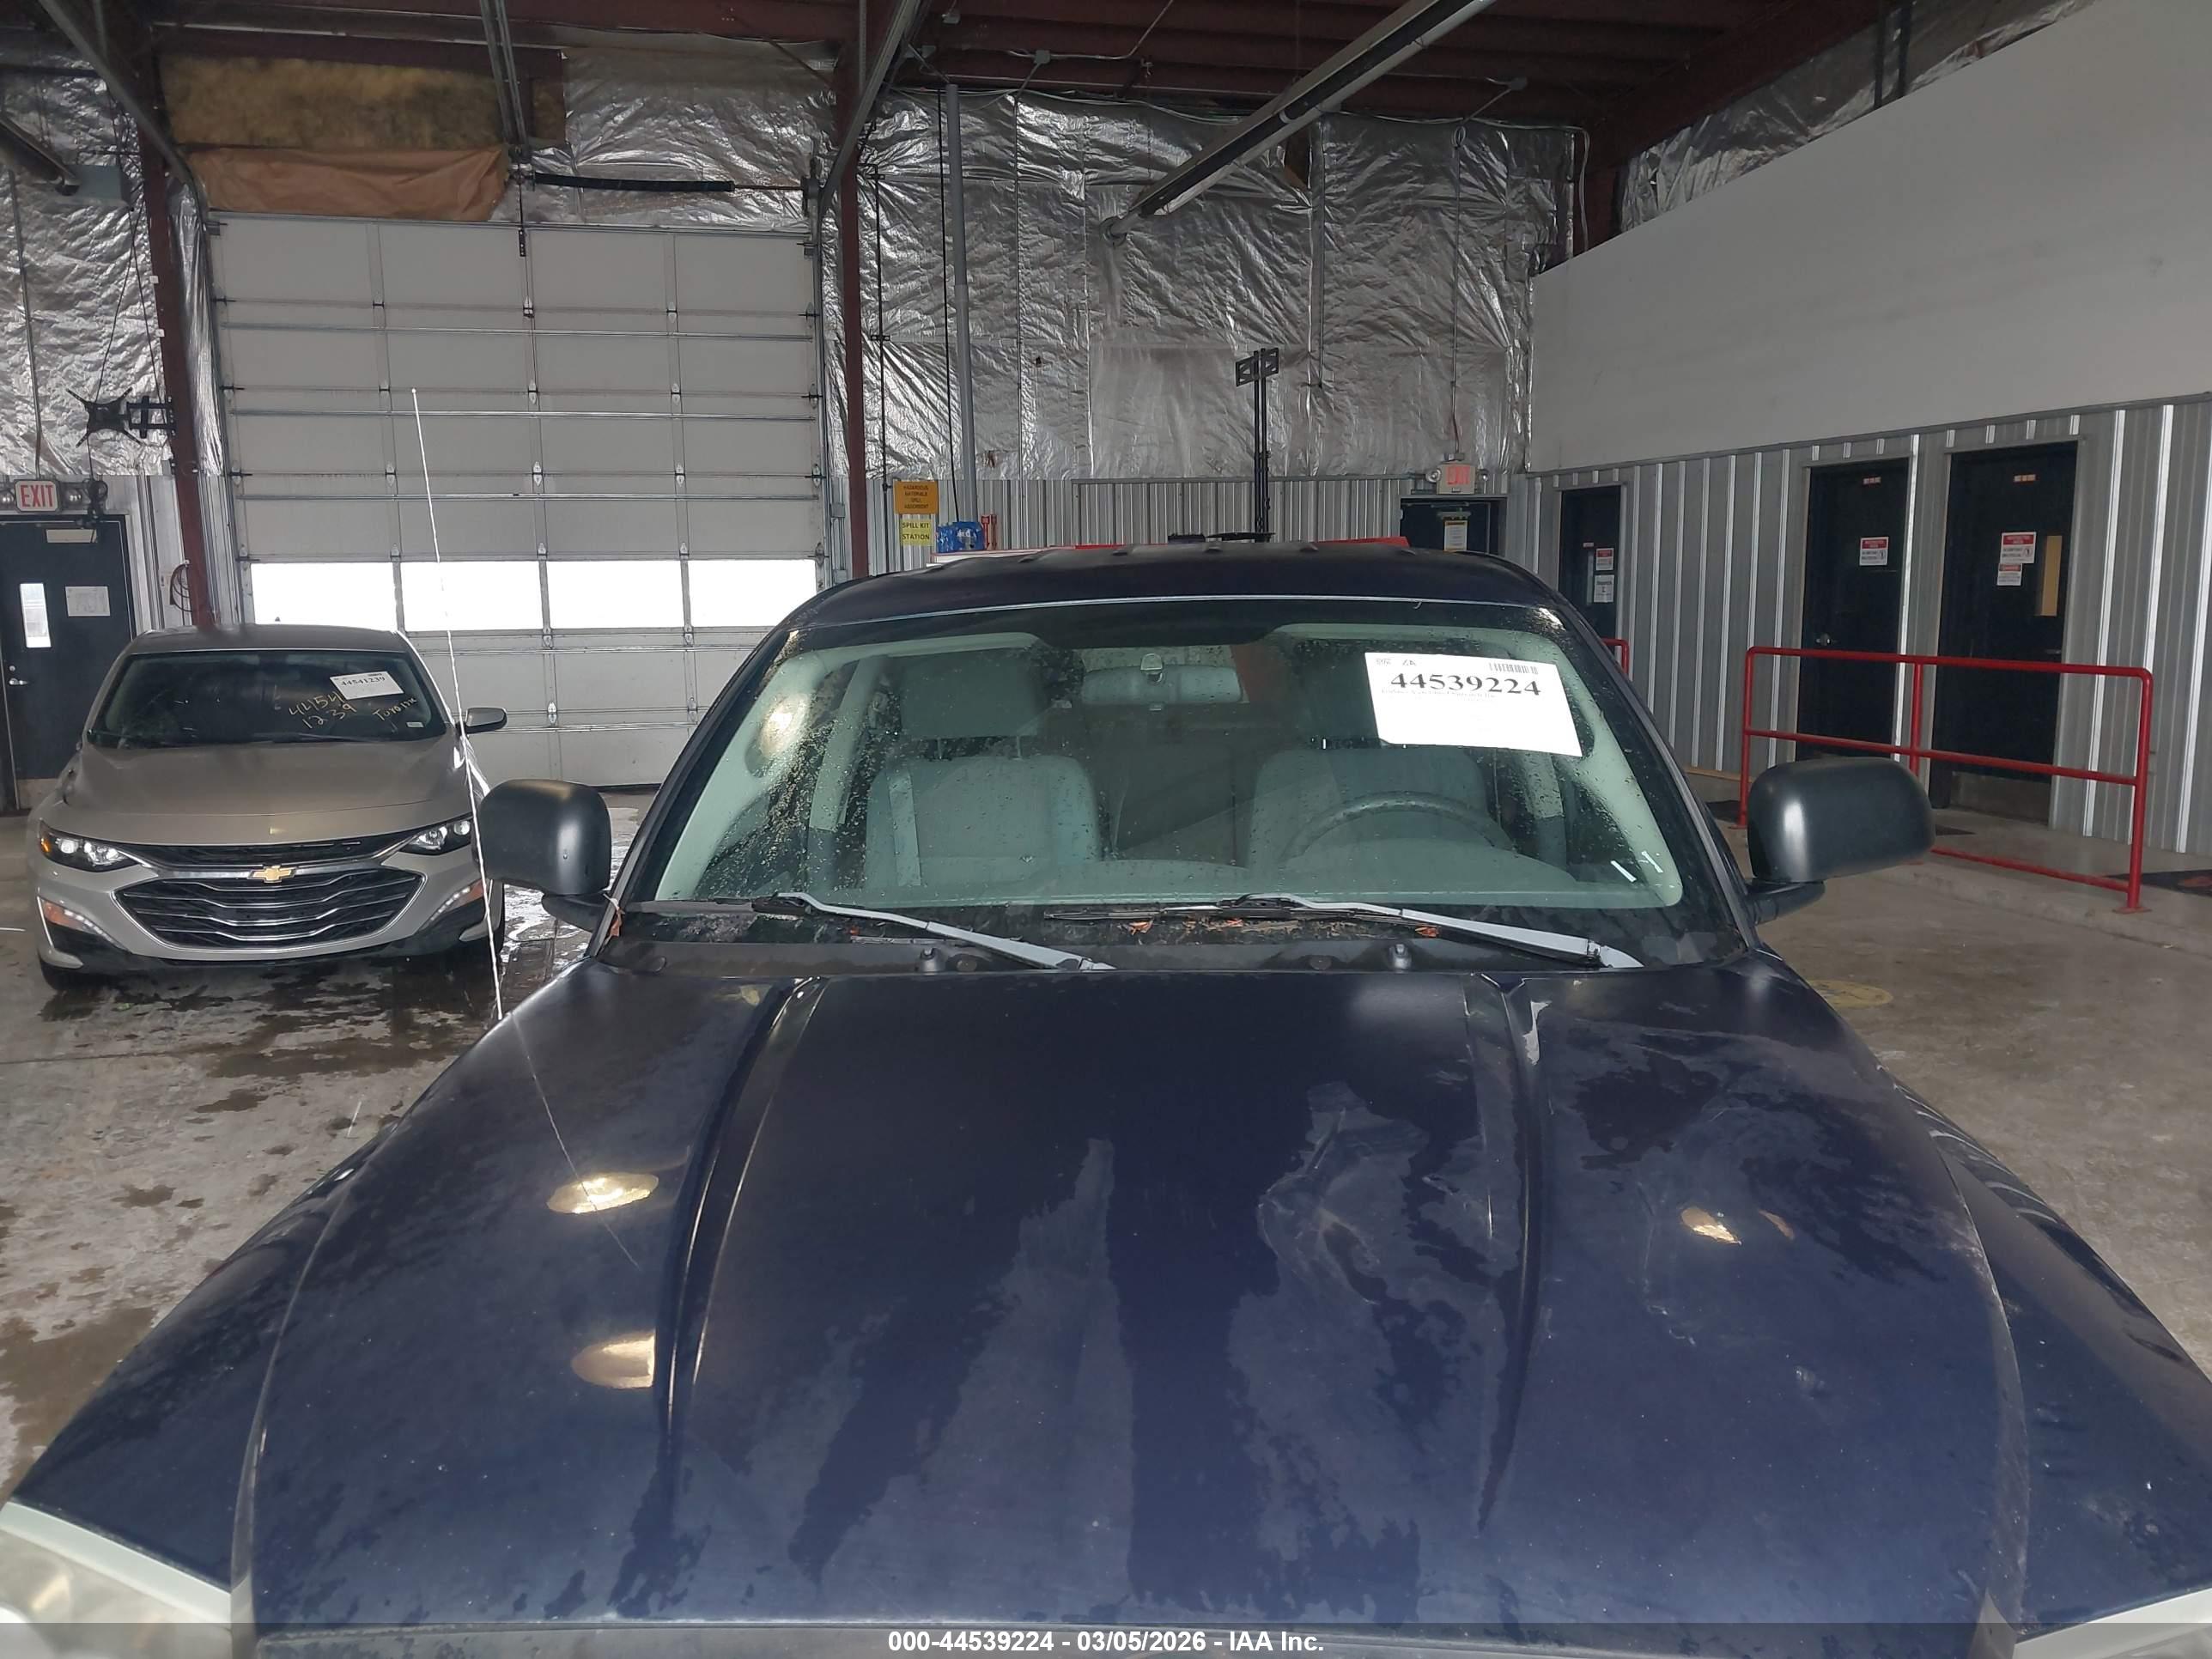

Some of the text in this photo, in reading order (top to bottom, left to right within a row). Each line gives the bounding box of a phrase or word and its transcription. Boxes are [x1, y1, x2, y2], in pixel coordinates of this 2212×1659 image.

[20, 484, 54, 507] EXIT
[340, 676, 386, 686] 44541239
[1390, 672, 1541, 696] 44539224
